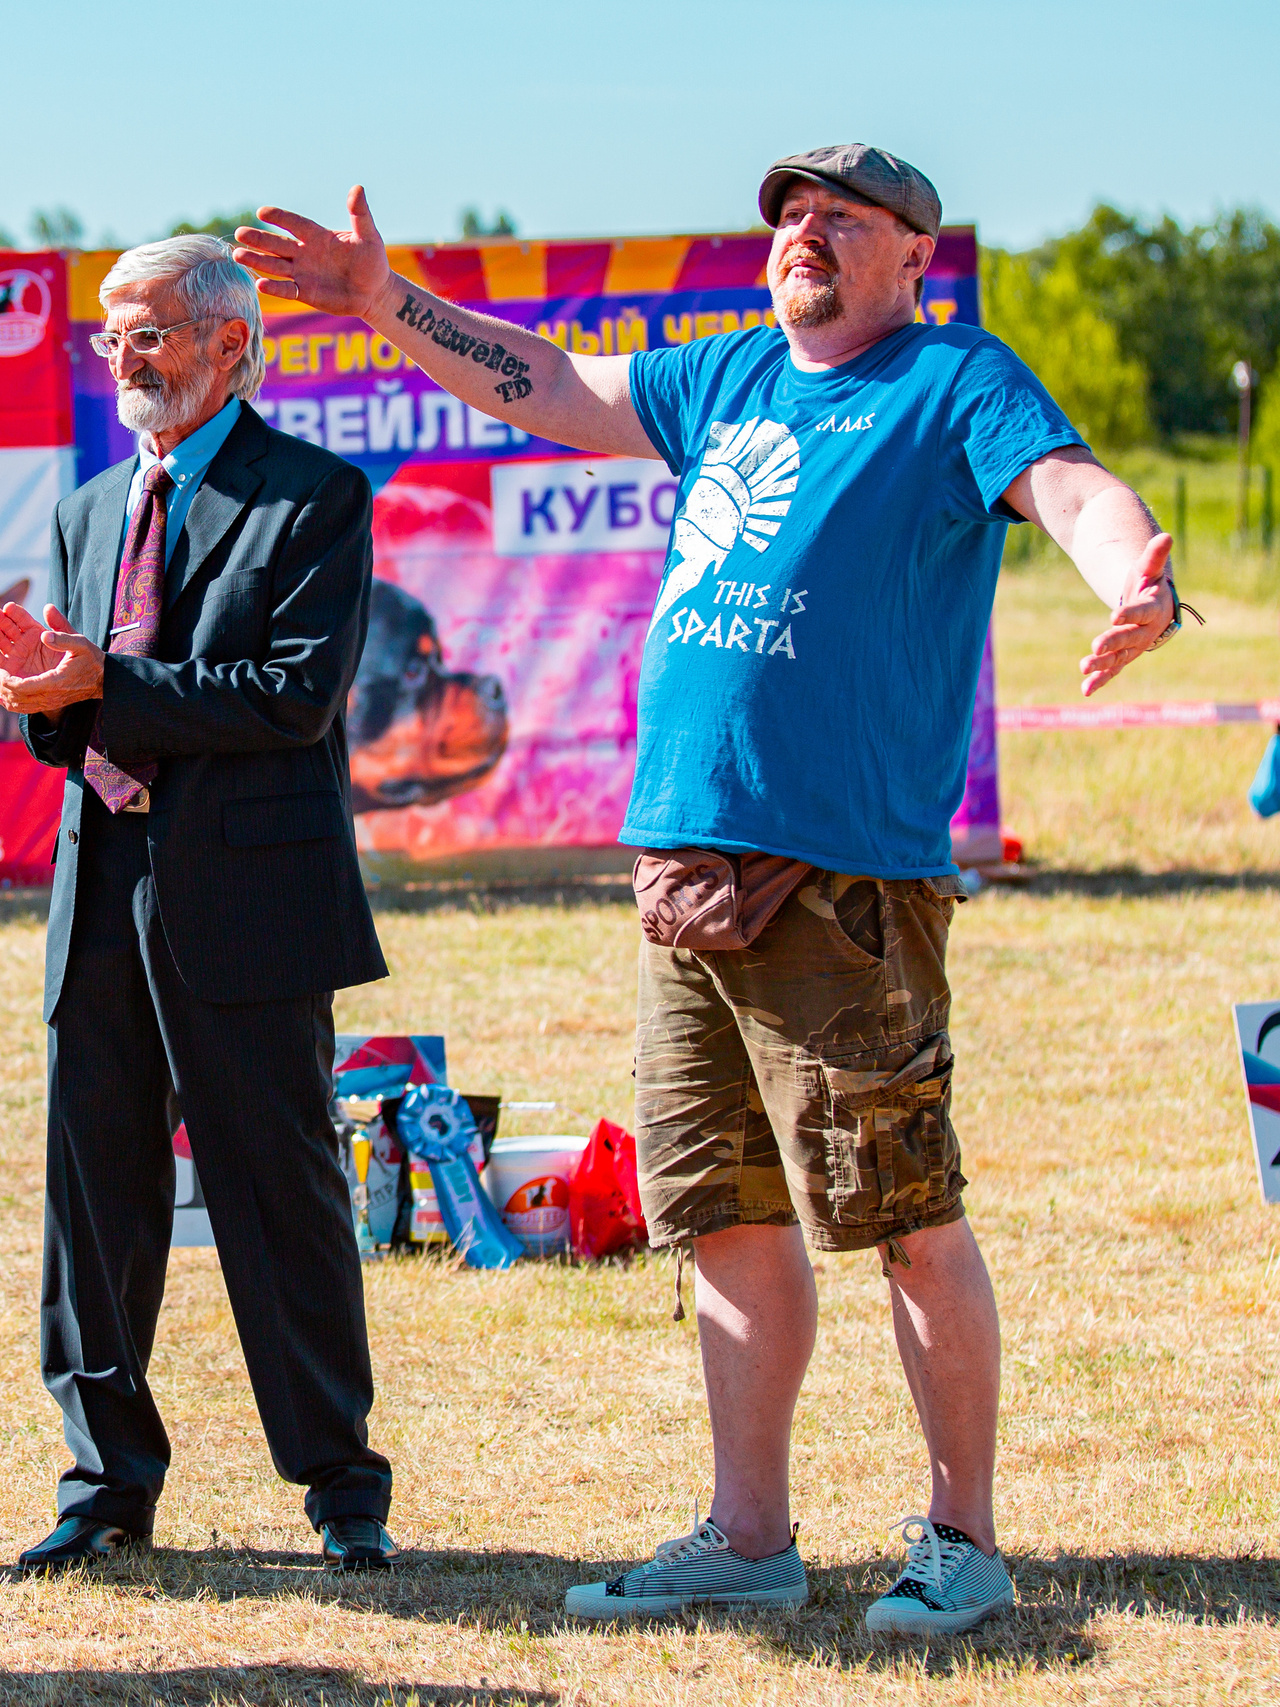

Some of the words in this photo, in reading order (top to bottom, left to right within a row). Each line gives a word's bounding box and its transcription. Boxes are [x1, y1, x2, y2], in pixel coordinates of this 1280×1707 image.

[713, 580, 771, 609] THIS
[780, 587, 809, 615] IS
[667, 606, 797, 660] SPARTA
